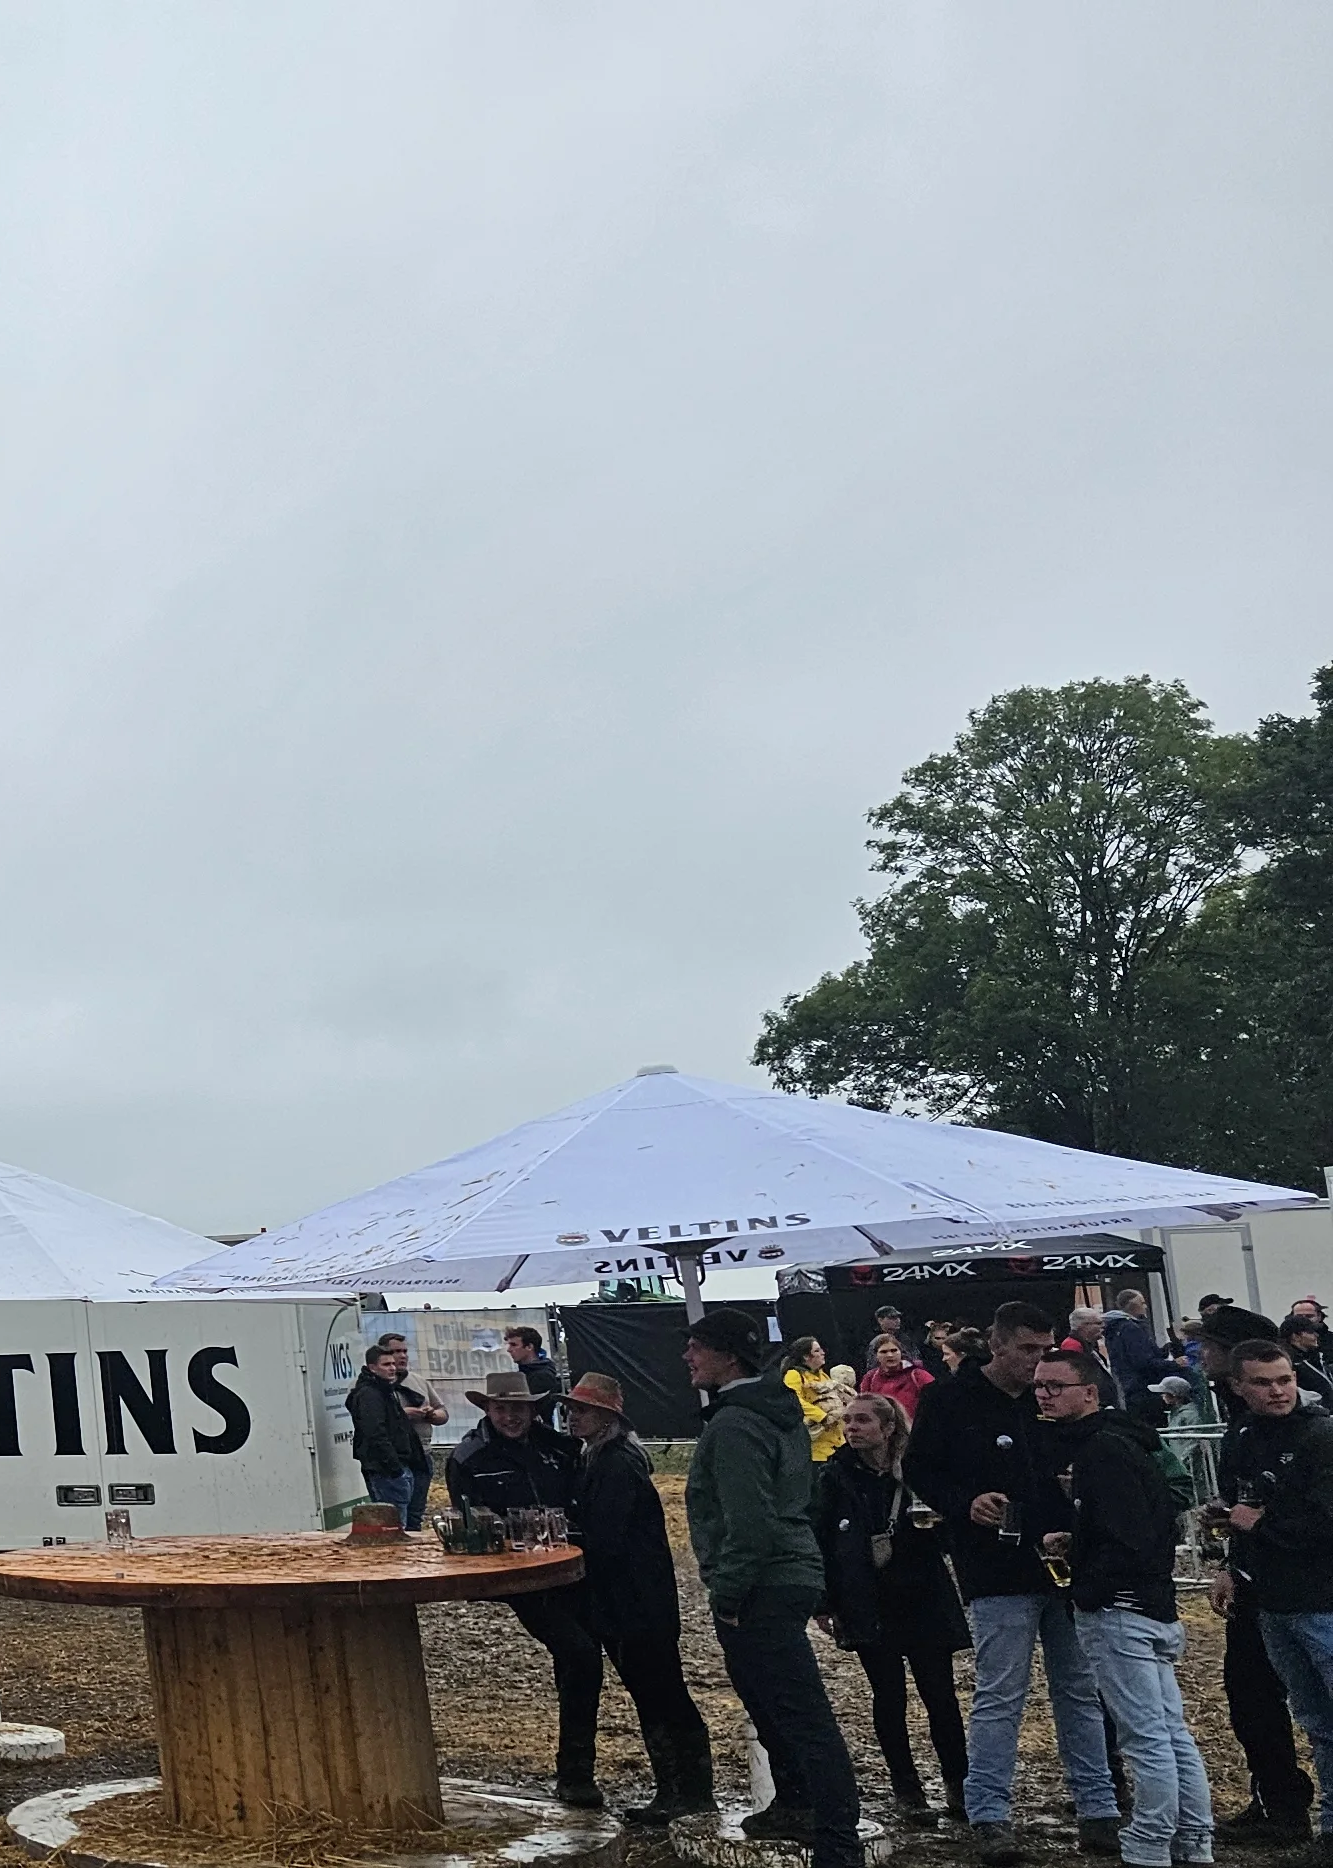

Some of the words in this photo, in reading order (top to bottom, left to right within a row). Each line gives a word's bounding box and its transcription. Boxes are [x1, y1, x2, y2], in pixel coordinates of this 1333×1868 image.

[600, 1212, 812, 1244] VELTINS
[882, 1261, 977, 1282] 24MX
[1042, 1253, 1139, 1270] 24MX
